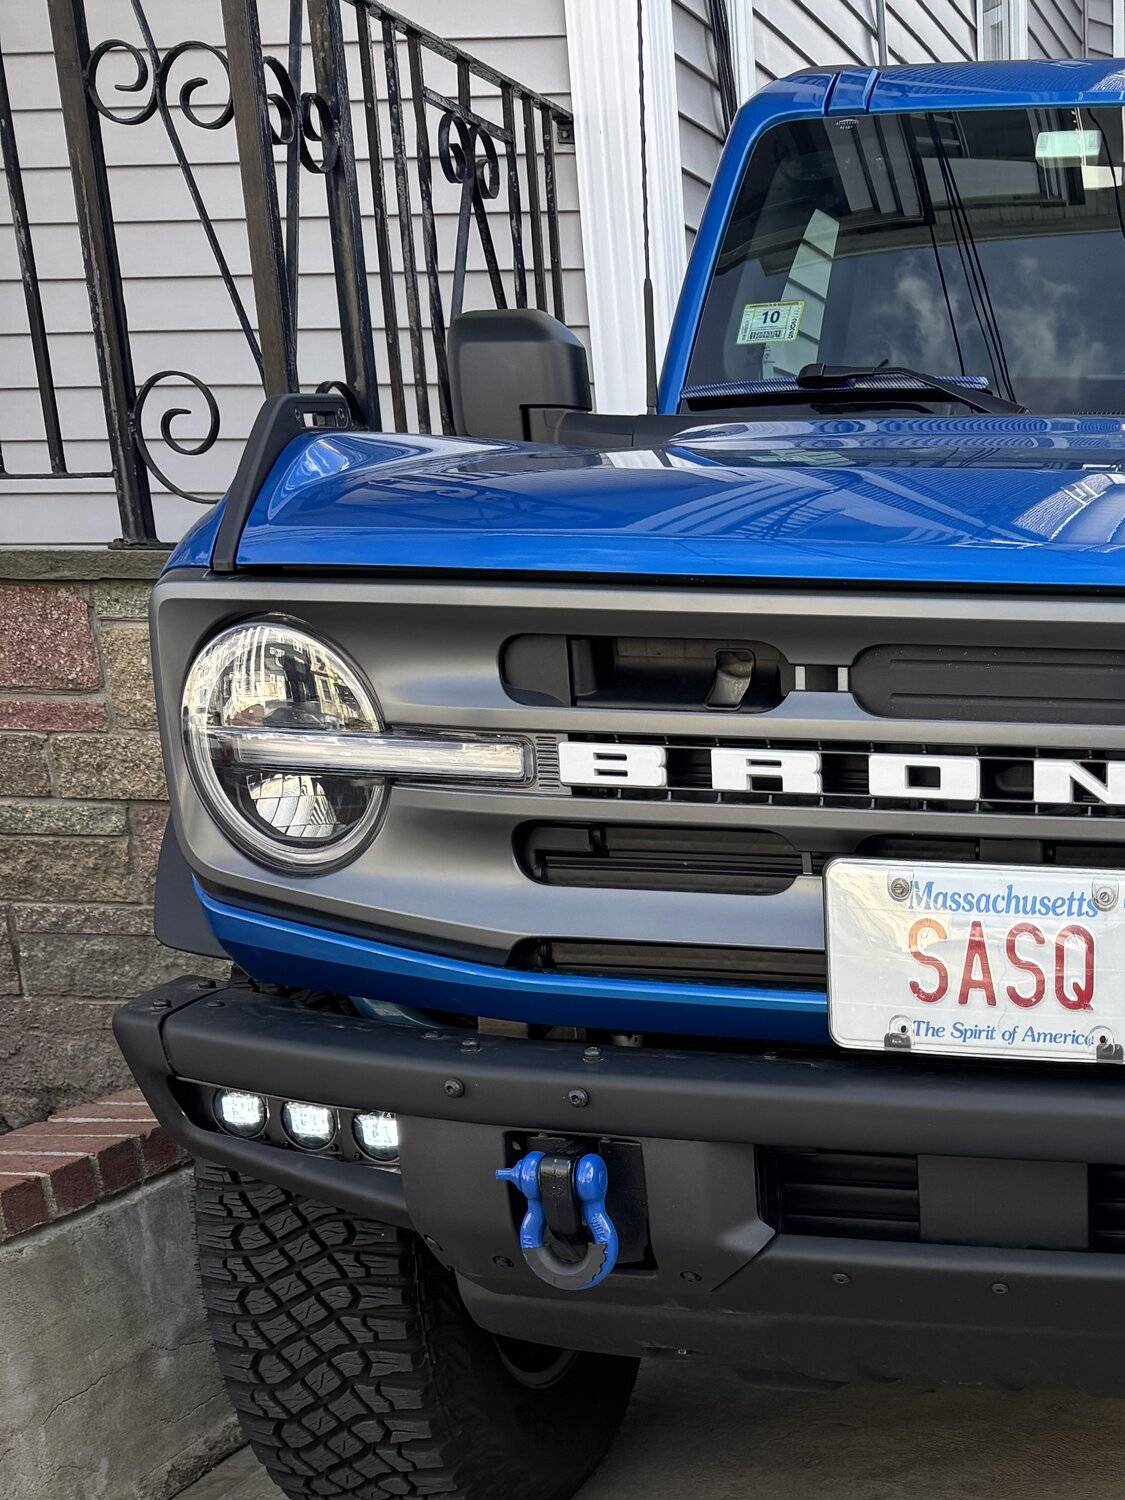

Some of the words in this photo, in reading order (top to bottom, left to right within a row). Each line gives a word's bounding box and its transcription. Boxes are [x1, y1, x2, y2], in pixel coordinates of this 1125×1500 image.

[762, 310, 780, 324] 10
[908, 880, 1099, 918] Massachusetts
[908, 917, 1095, 1012] SASQ
[912, 1020, 946, 1038] The
[950, 1021, 997, 1043] Spirit
[1001, 1025, 1019, 1046] of
[1021, 1025, 1095, 1046] America
